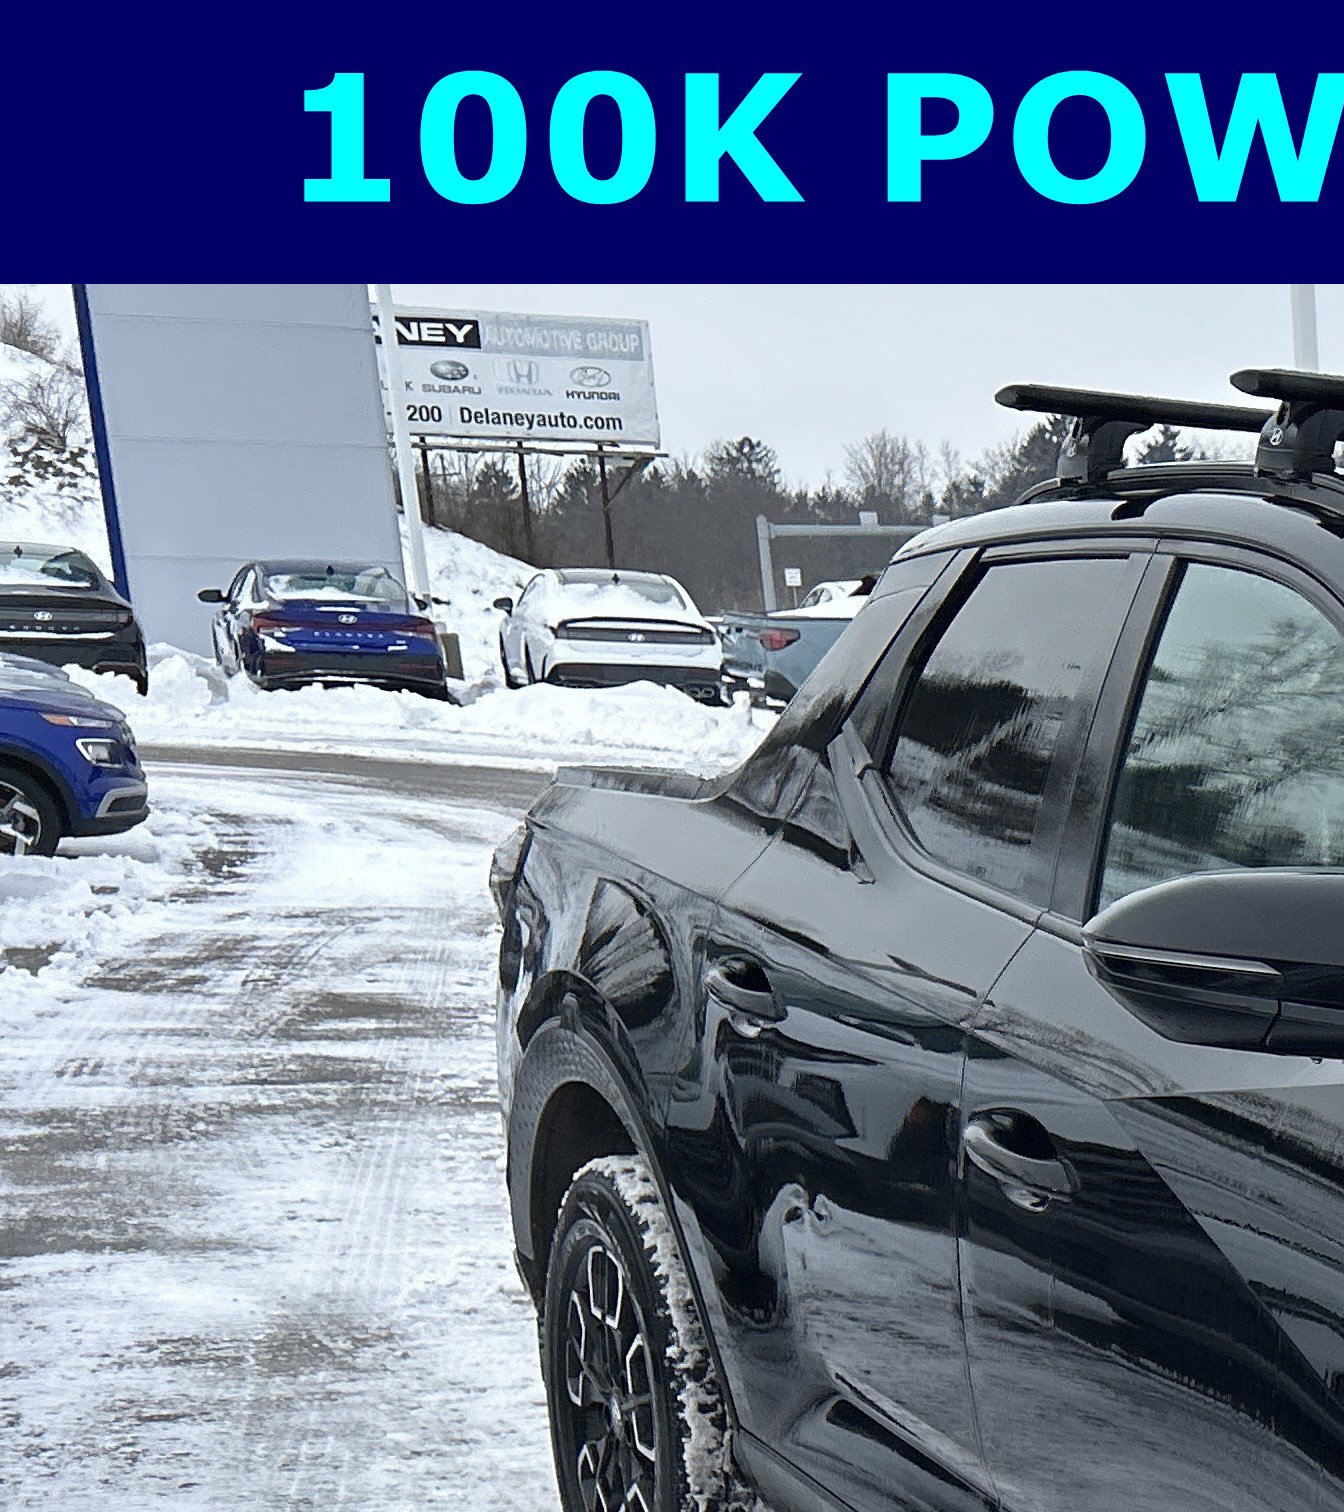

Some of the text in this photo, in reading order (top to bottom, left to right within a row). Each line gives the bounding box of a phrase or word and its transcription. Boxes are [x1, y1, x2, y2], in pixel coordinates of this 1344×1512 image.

[374, 320, 640, 353] NEY AUTOMOTIVE GROUP
[421, 384, 481, 394] SUBARU
[565, 390, 621, 401] HYUNDAI
[406, 404, 623, 431] 200 Delaneyauto.com
